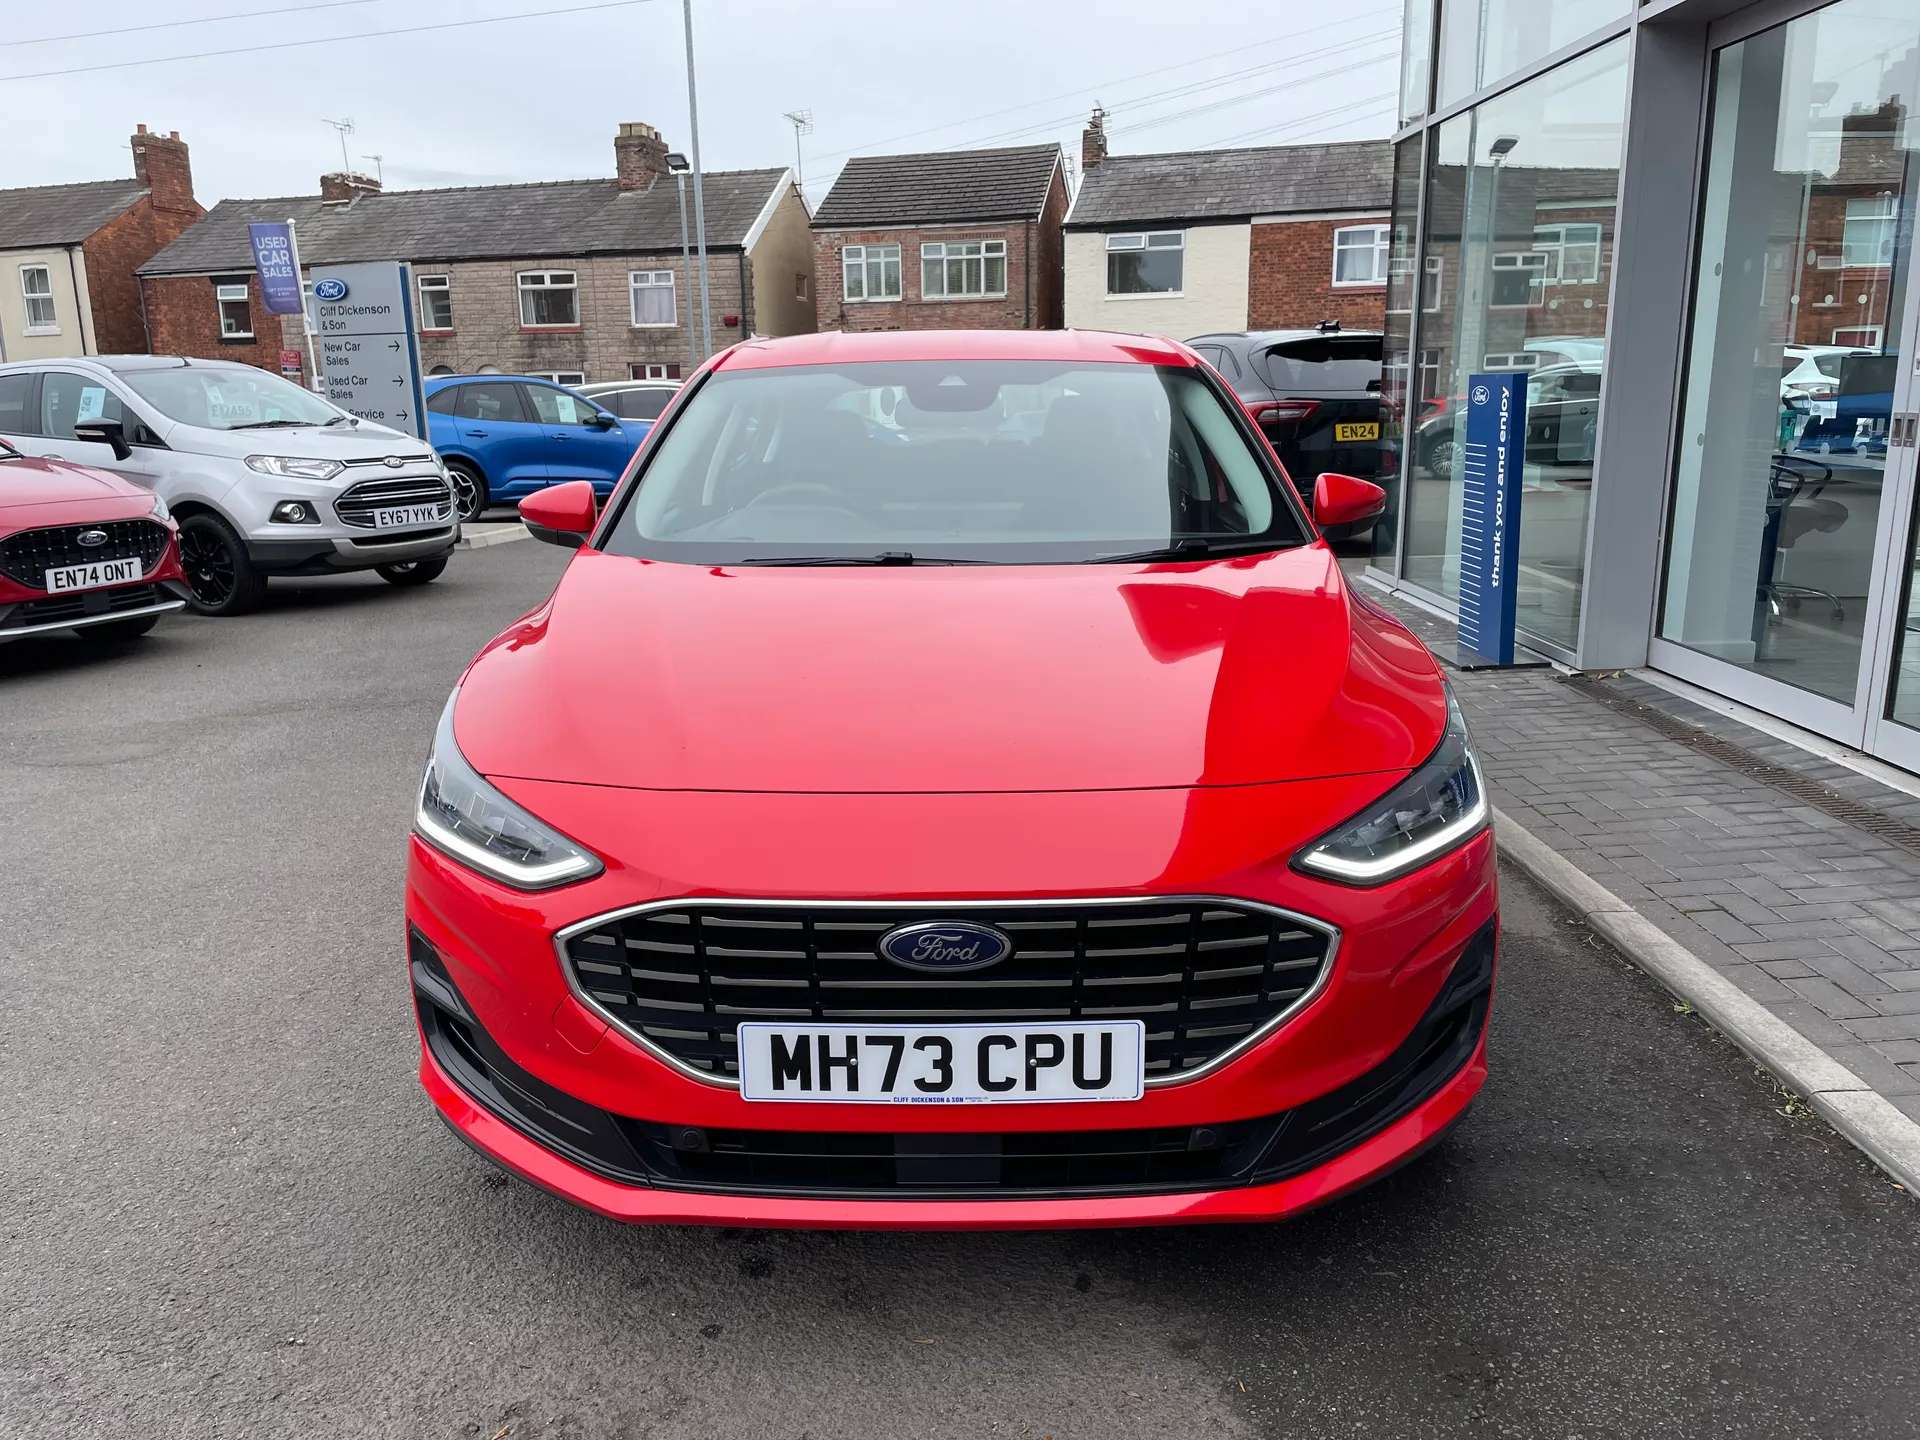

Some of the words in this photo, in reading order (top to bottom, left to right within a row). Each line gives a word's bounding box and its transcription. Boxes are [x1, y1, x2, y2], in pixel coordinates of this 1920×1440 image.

[256, 237, 288, 249] USED
[259, 250, 291, 266] CAR
[262, 266, 294, 278] SALES
[320, 282, 339, 297] Ford
[320, 305, 336, 317] Cliff
[338, 304, 391, 316] Dickenson
[322, 321, 328, 331] &
[329, 320, 346, 330] Son
[324, 342, 343, 352] New
[344, 341, 361, 352] Car
[326, 355, 350, 366] Sales
[328, 375, 350, 386] Used
[351, 375, 368, 386] Car
[330, 389, 354, 400] Sales
[348, 408, 385, 420] Service
[1499, 386, 1510, 442] enjoy
[1341, 424, 1376, 439] EN24
[1497, 447, 1506, 486] and
[1495, 489, 1504, 527] you
[380, 509, 410, 525] EY67
[412, 507, 435, 522] YYK
[1491, 529, 1503, 588] thank
[53, 566, 100, 589] EN74
[103, 561, 134, 582] ONT
[911, 934, 979, 961] Ford
[770, 1034, 953, 1093] MH73
[977, 1032, 1113, 1092] CPU
